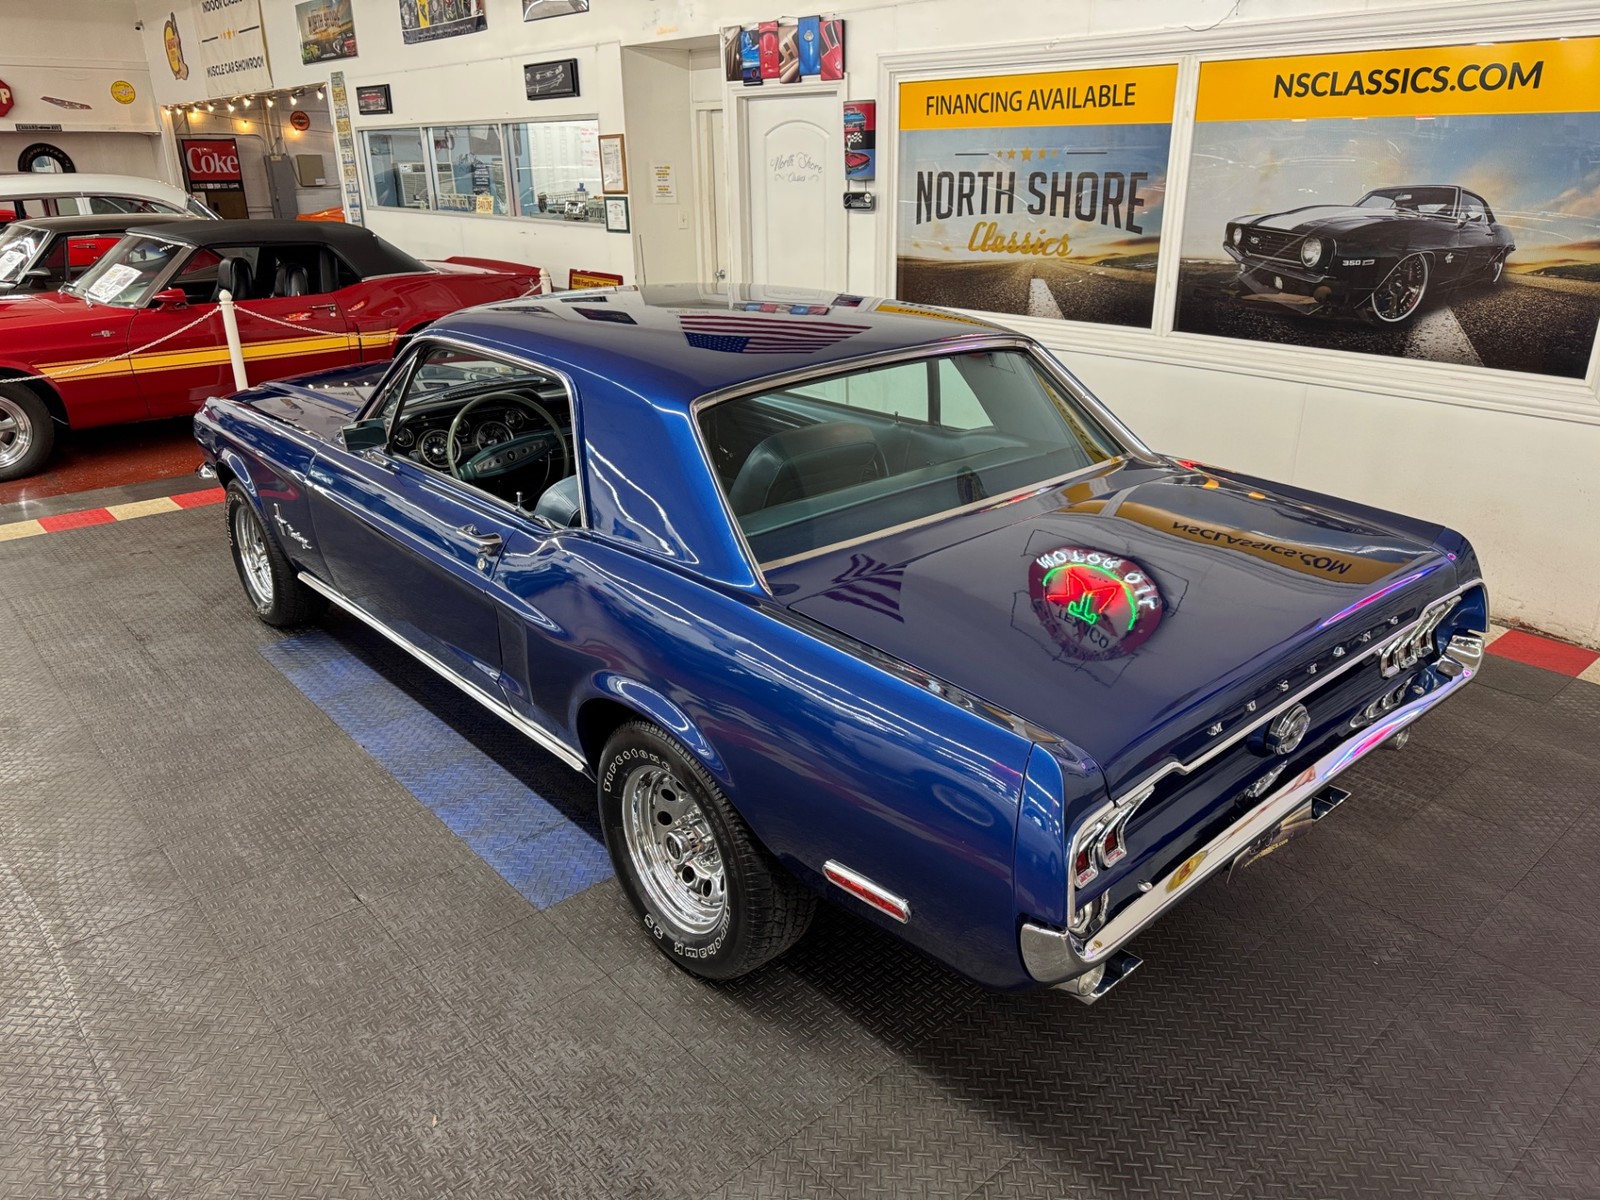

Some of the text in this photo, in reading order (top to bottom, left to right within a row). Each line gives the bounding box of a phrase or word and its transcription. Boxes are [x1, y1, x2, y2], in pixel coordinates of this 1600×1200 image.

[206, 63, 225, 78] MUSCLE
[225, 60, 235, 75] CAR
[1273, 60, 1545, 99] NSCLASSICS.COM
[926, 82, 1137, 116] FINANCING AVAILABLE
[187, 147, 239, 173] Coke
[796, 152, 822, 173] Shore
[916, 171, 1148, 235] NORTH SHORE
[967, 221, 1073, 257] Classics
